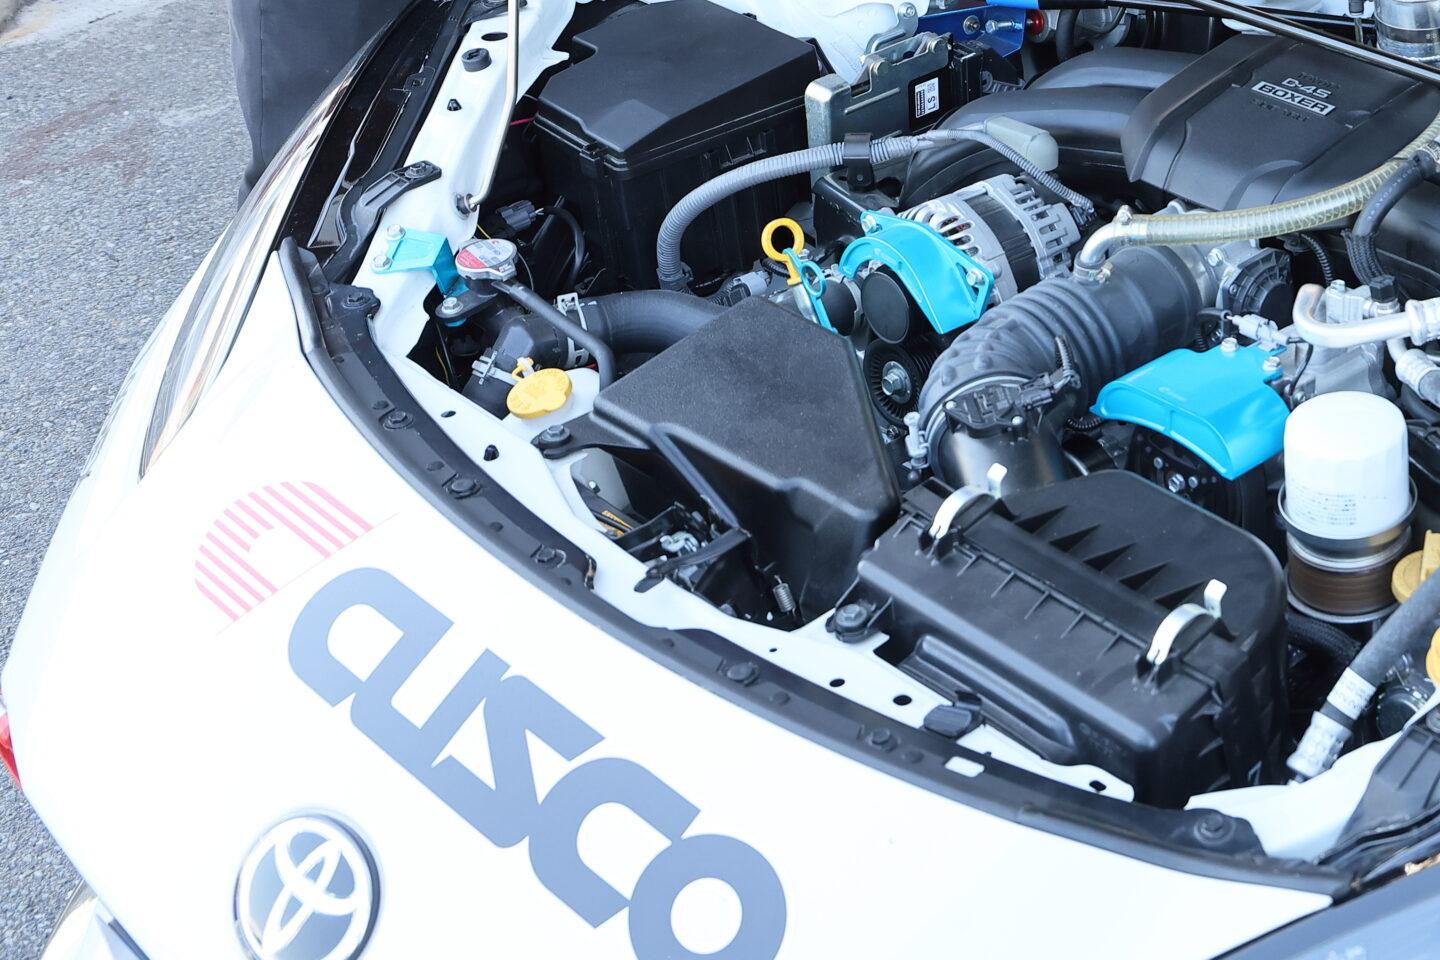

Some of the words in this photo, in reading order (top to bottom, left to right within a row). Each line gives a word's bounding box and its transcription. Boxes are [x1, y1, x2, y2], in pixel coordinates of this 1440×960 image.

[1257, 83, 1329, 113] BOXER
[1281, 77, 1332, 99] D-4S
[288, 566, 788, 960] CUSCO
